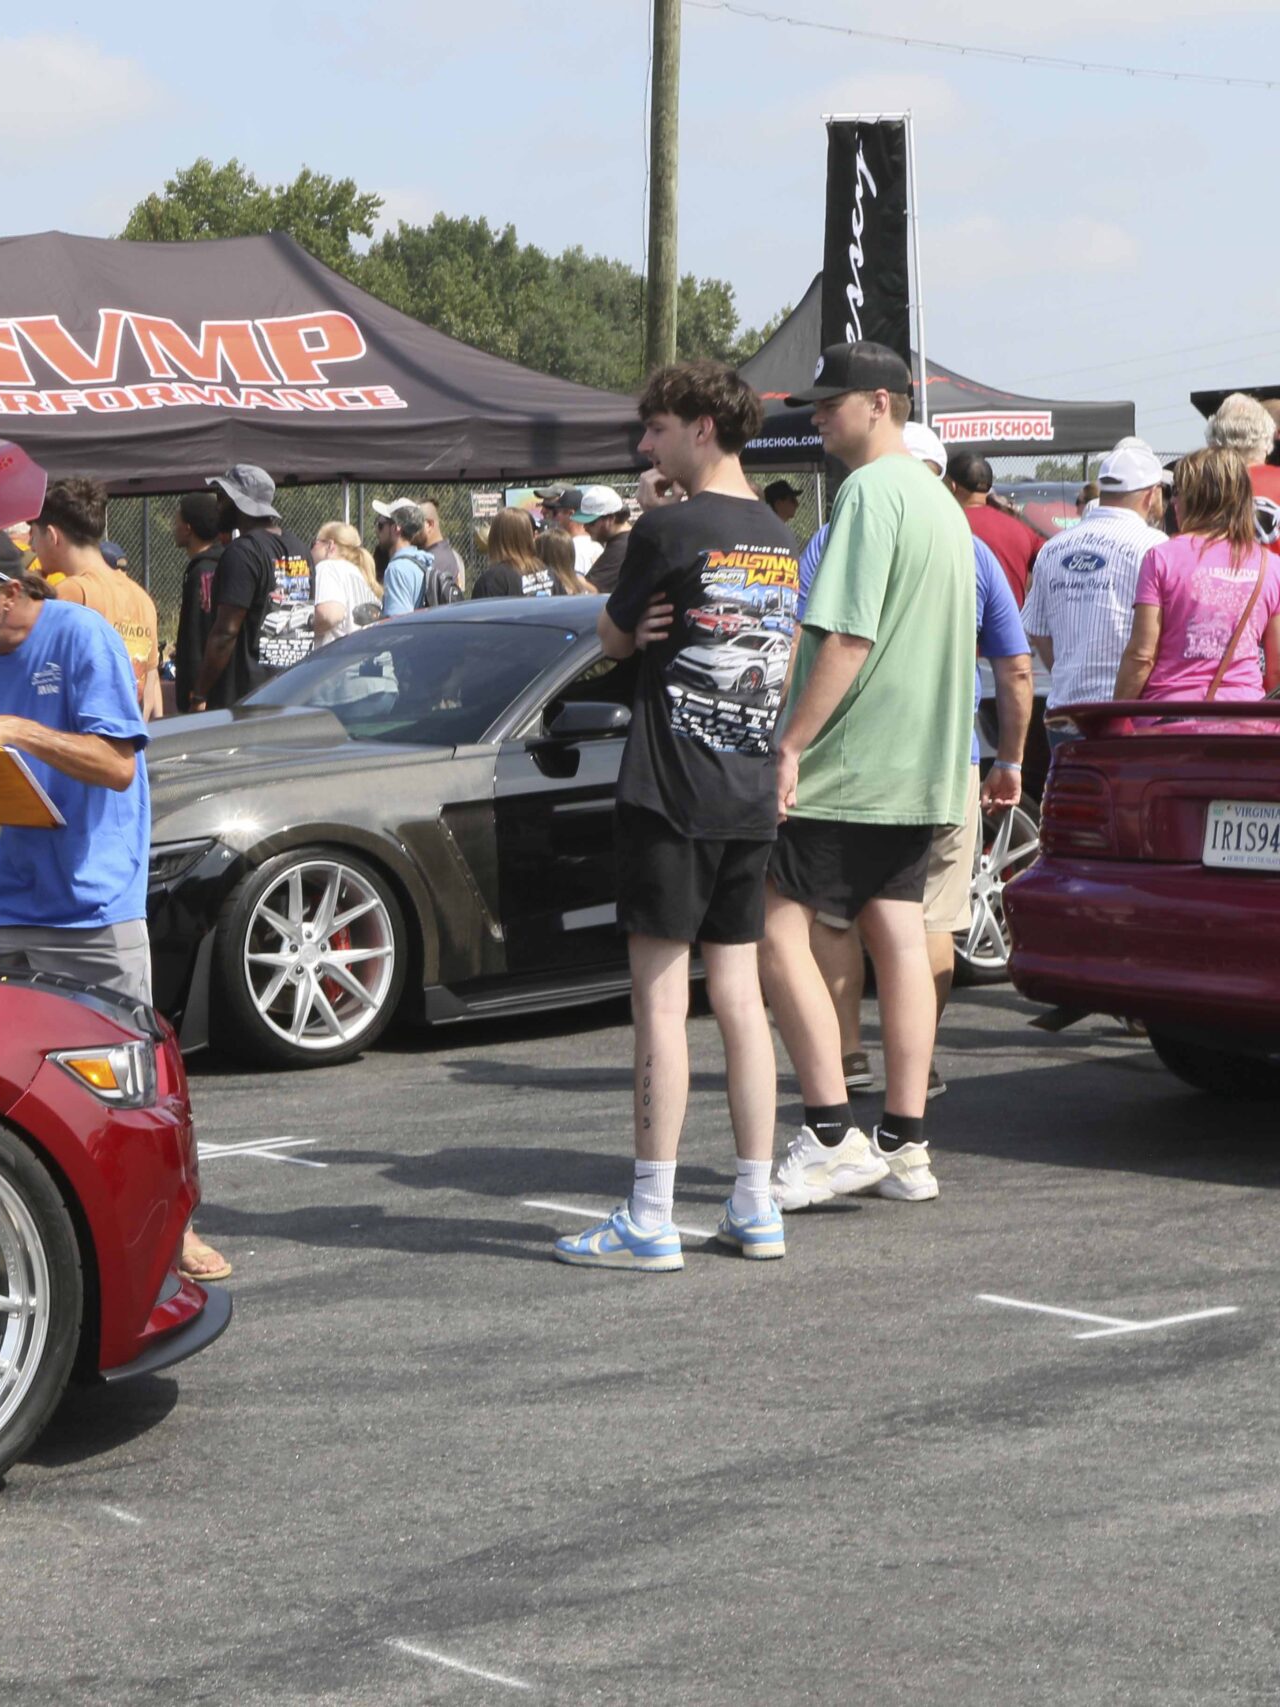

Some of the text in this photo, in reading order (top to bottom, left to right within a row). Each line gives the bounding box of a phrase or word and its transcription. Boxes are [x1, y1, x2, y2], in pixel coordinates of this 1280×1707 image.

[10, 308, 367, 385] VMP
[934, 417, 1051, 440] TUNER SCHOOL
[744, 436, 823, 448] NERSCHOOL.COM
[1068, 555, 1100, 571] Ford
